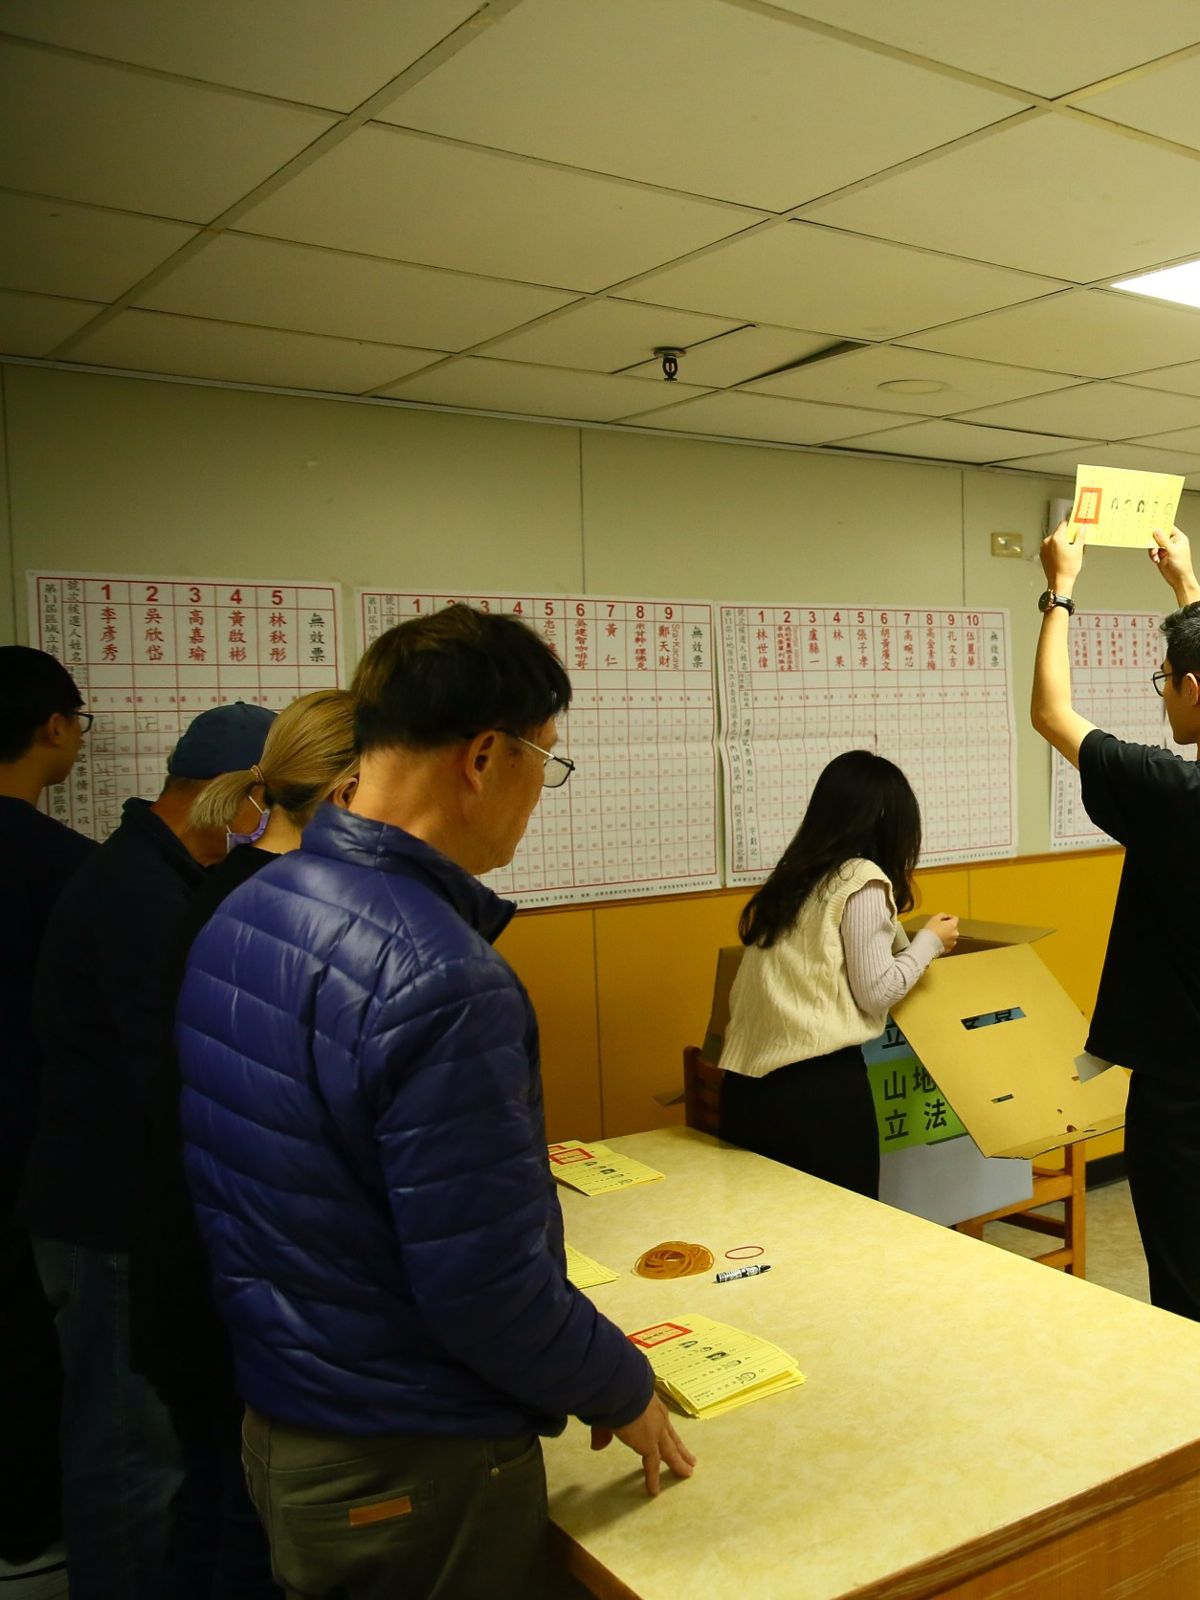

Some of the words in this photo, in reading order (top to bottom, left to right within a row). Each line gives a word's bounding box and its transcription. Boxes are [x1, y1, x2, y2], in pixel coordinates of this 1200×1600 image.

[101, 584, 111, 600] 1
[146, 586, 158, 602] 2
[189, 587, 201, 603] 3
[230, 589, 243, 605] 4
[271, 590, 283, 606] 5
[412, 599, 421, 613] 1
[480, 601, 489, 614] 3
[513, 601, 523, 615] 4
[545, 602, 554, 615] 5
[576, 602, 585, 617] 6
[606, 604, 615, 618] 7
[636, 605, 645, 619] 8
[664, 606, 673, 620] 9
[758, 611, 765, 623] 1
[783, 611, 791, 623] 2
[809, 611, 816, 623] 3
[833, 611, 841, 623] 4
[857, 612, 865, 624] 5
[880, 613, 888, 625] 6
[904, 613, 911, 625] 7
[926, 613, 933, 625] 8
[947, 614, 955, 626] 9
[967, 614, 979, 626] 10
[1077, 617, 1082, 627] 1
[1095, 617, 1101, 628] 2
[1113, 617, 1119, 628] 3
[1131, 618, 1137, 628] 4
[1148, 618, 1154, 628] 5
[101, 607, 118, 661] 李彥秀
[144, 608, 164, 661] 吳欣岱
[188, 609, 206, 661] 高嘉瑜
[308, 612, 326, 663] 無效票
[658, 625, 670, 668] 鄭天財
[691, 626, 703, 668] 無效票
[756, 628, 768, 669] 林世偉
[884, 1065, 938, 1101] 山地
[885, 1098, 947, 1142] 立法
